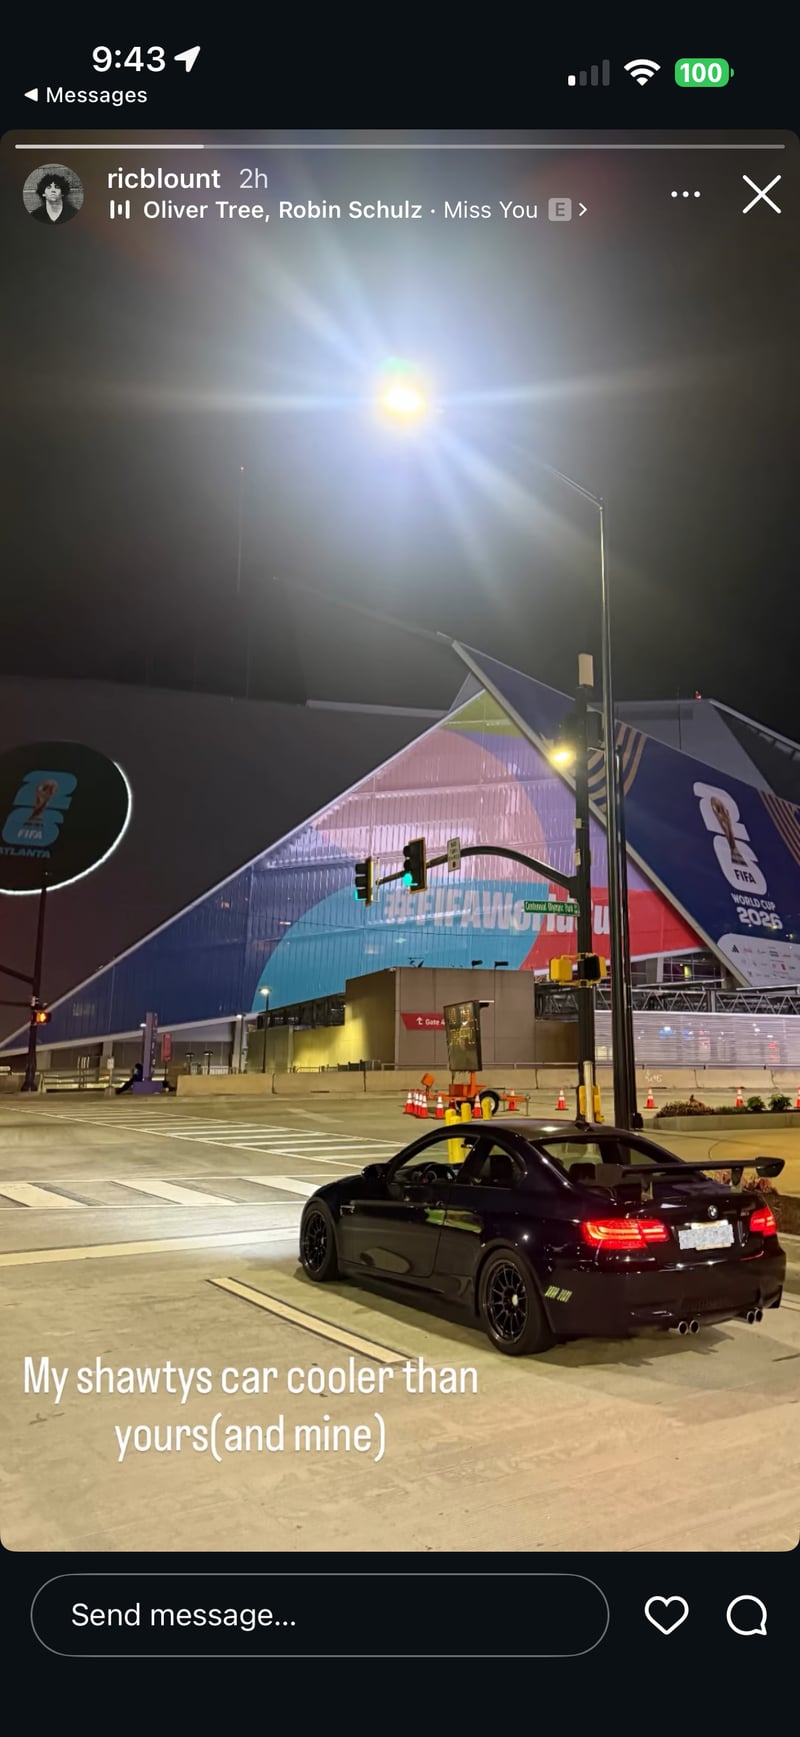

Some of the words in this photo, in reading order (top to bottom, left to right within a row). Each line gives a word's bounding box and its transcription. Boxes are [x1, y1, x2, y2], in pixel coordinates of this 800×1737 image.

[17, 829, 43, 840] FIFA
[734, 869, 757, 885] FIFA
[731, 893, 761, 909] WORLD
[760, 899, 776, 912] CUP
[736, 907, 784, 930] 2026
